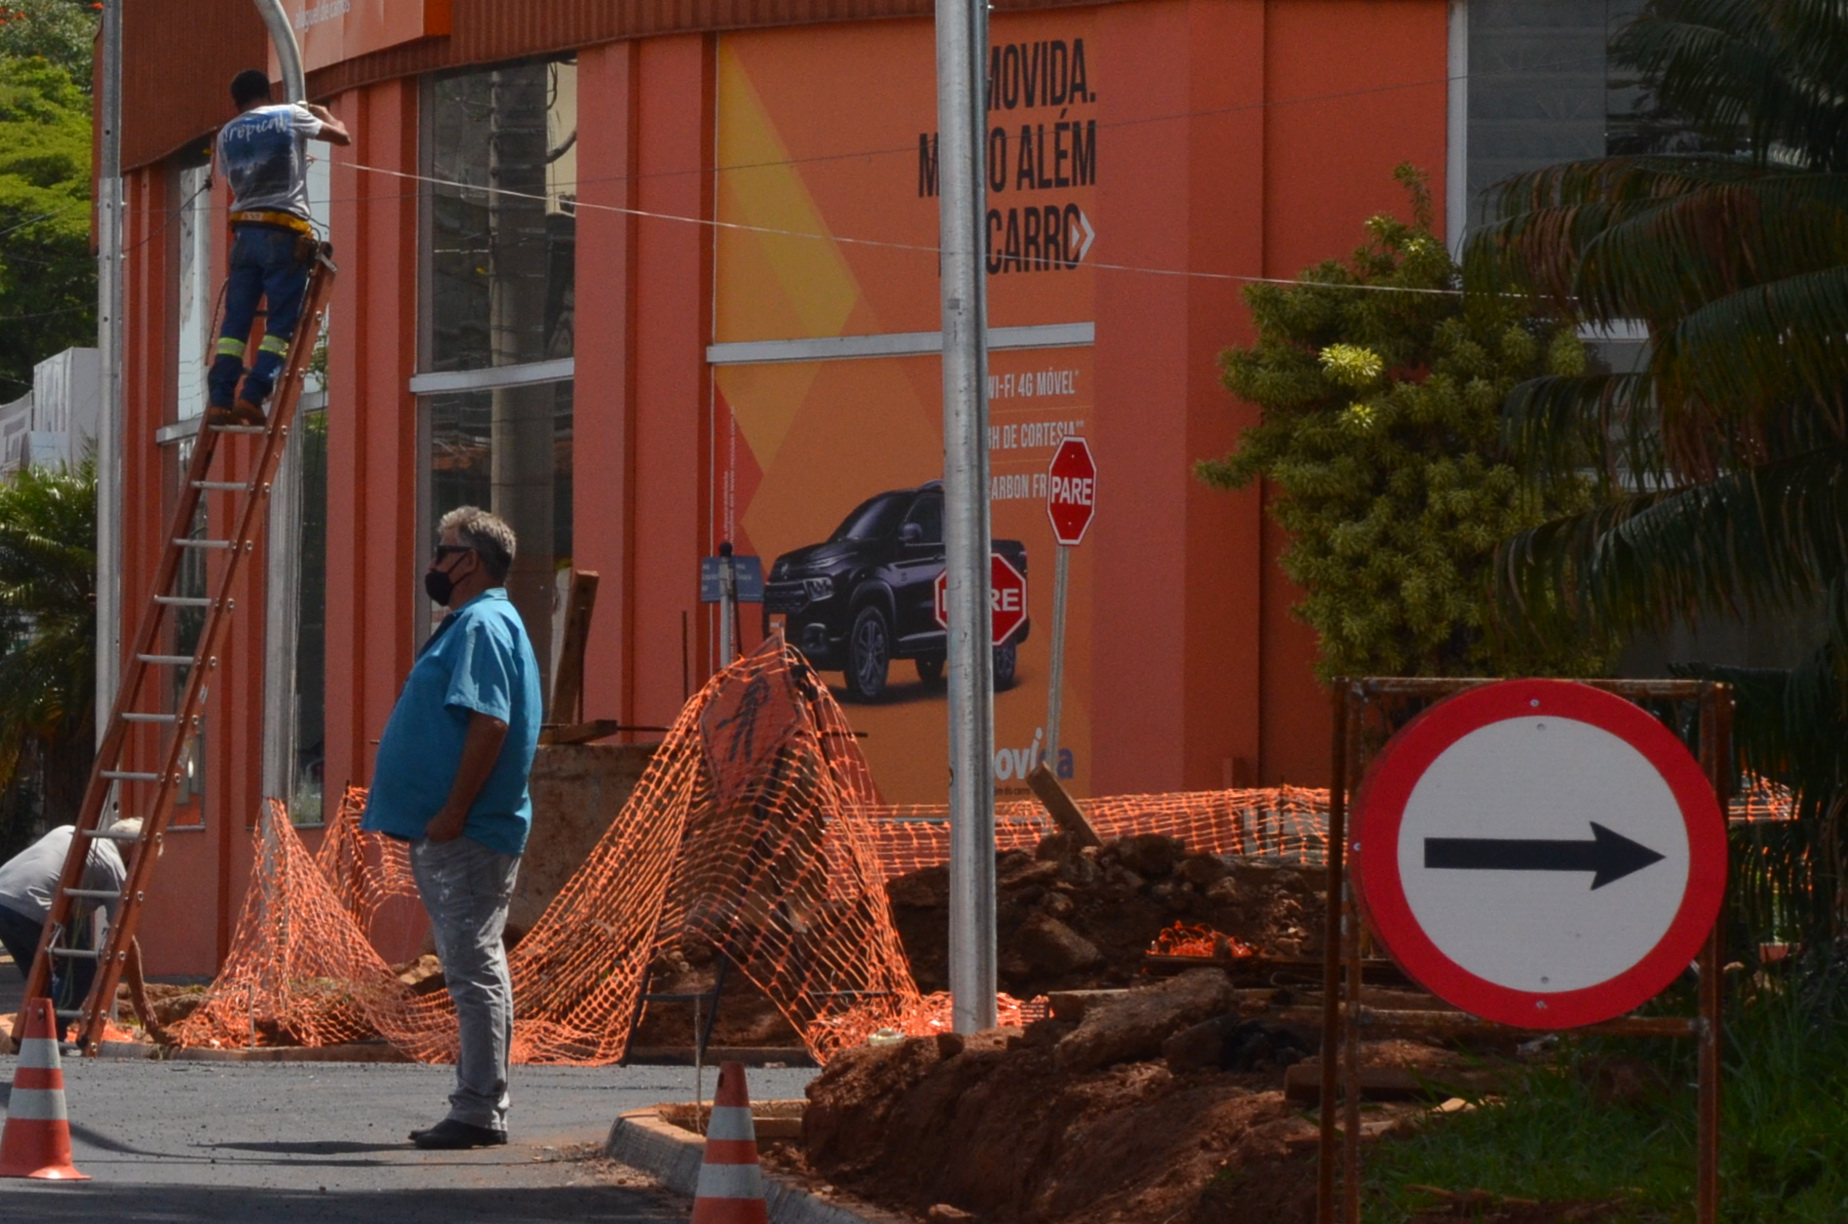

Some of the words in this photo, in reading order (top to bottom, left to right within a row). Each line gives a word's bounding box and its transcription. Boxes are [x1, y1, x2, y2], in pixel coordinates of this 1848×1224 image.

[1016, 107, 1096, 191] ALÉM
[986, 203, 1082, 275] CARRO
[1018, 373, 1033, 397] 4G
[1003, 424, 1017, 449] DE
[991, 474, 1030, 500] ARBON
[1032, 473, 1048, 498] FR
[1051, 476, 1093, 506] PARE
[994, 726, 1074, 781] ovia
